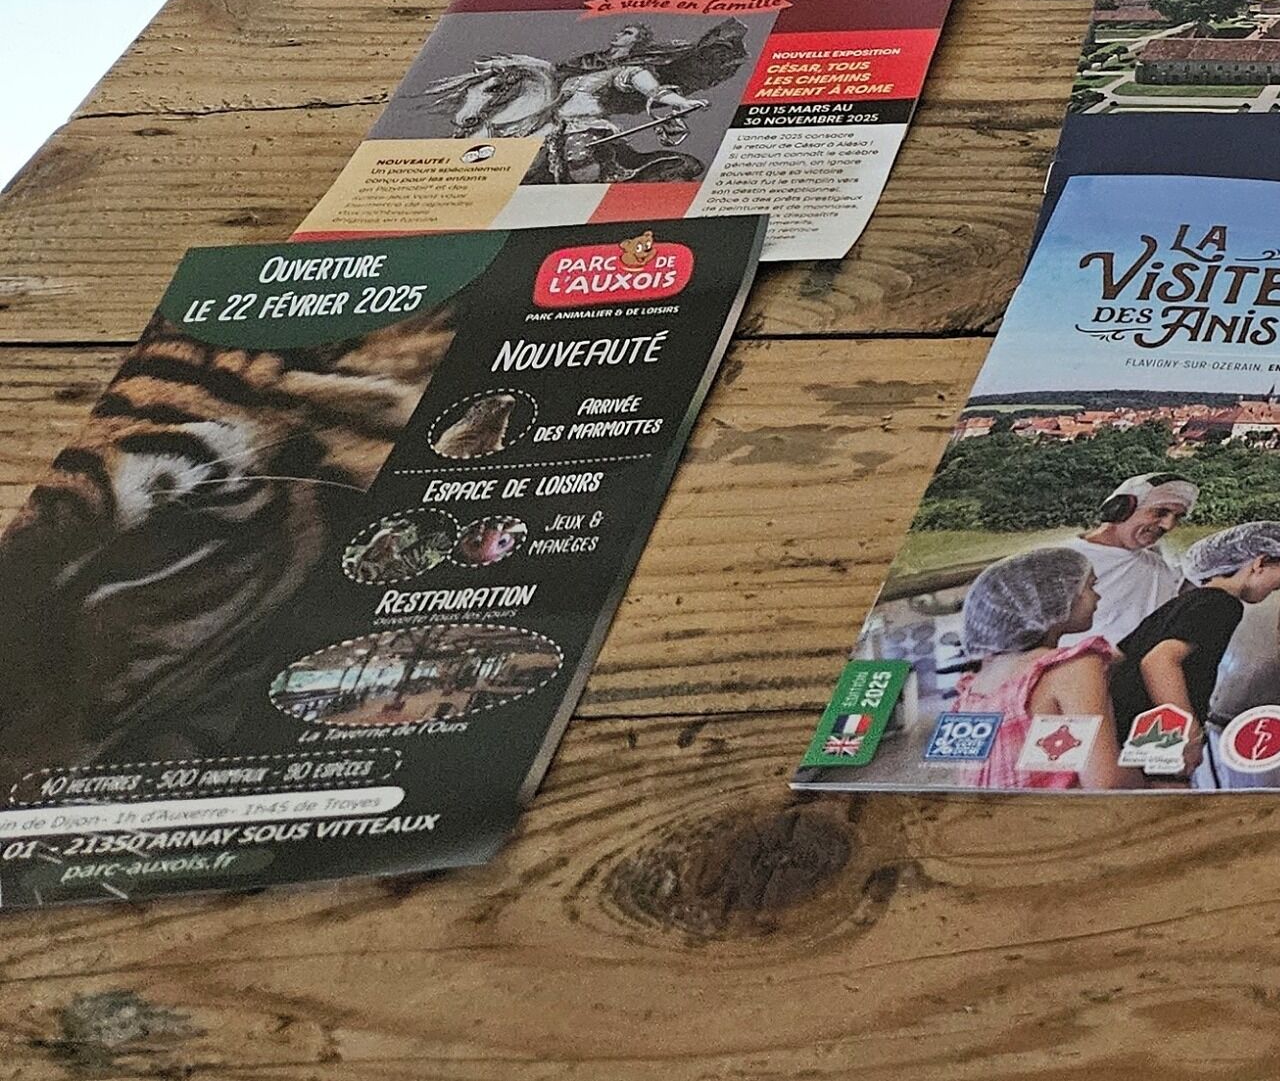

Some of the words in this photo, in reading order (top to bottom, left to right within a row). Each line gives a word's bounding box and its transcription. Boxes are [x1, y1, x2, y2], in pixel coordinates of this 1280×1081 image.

[764, 75, 794, 86] LES
[795, 72, 871, 85] CHEMINS
[766, 62, 823, 74] CÉSAR,
[827, 61, 871, 71] TOUS
[743, 118, 762, 126] 30
[763, 115, 845, 125] NOVEMBRE
[847, 113, 879, 122] 2025
[748, 106, 771, 115] DU
[772, 106, 785, 114] 15
[785, 105, 831, 114] MARS
[832, 104, 853, 112] AU
[1170, 224, 1228, 262] LA
[258, 255, 387, 283] OUVERTURE
[557, 255, 617, 273] PARC
[655, 256, 676, 268] DE
[549, 270, 677, 294] L'AUXOIS
[183, 299, 216, 323] LE
[218, 293, 257, 321] 22
[258, 291, 350, 319] FÉVRIER
[354, 285, 428, 314] 2025
[525, 313, 553, 322] PARC
[554, 309, 613, 320] ANIMALIER
[626, 308, 640, 316] DE
[641, 305, 680, 315] LOISIRS
[1091, 306, 1153, 324] DES
[491, 330, 669, 372] NOUVEAUTÉ
[577, 394, 642, 416] ARRIVÉE
[533, 426, 564, 443] DES
[567, 419, 664, 440] MARMOTTES
[422, 479, 498, 503] ESPACE
[501, 478, 531, 499] DE
[535, 472, 604, 497] LOISIRS
[545, 513, 585, 532] JEUX
[589, 510, 604, 528] &
[528, 535, 599, 556] MANÈGES
[375, 584, 537, 615] RESTAURATION
[147, 827, 240, 849] ARNAY
[238, 821, 311, 843] SOUS
[316, 813, 441, 838] VITTEAUX
[60, 851, 238, 884] parc-auxois.fr
